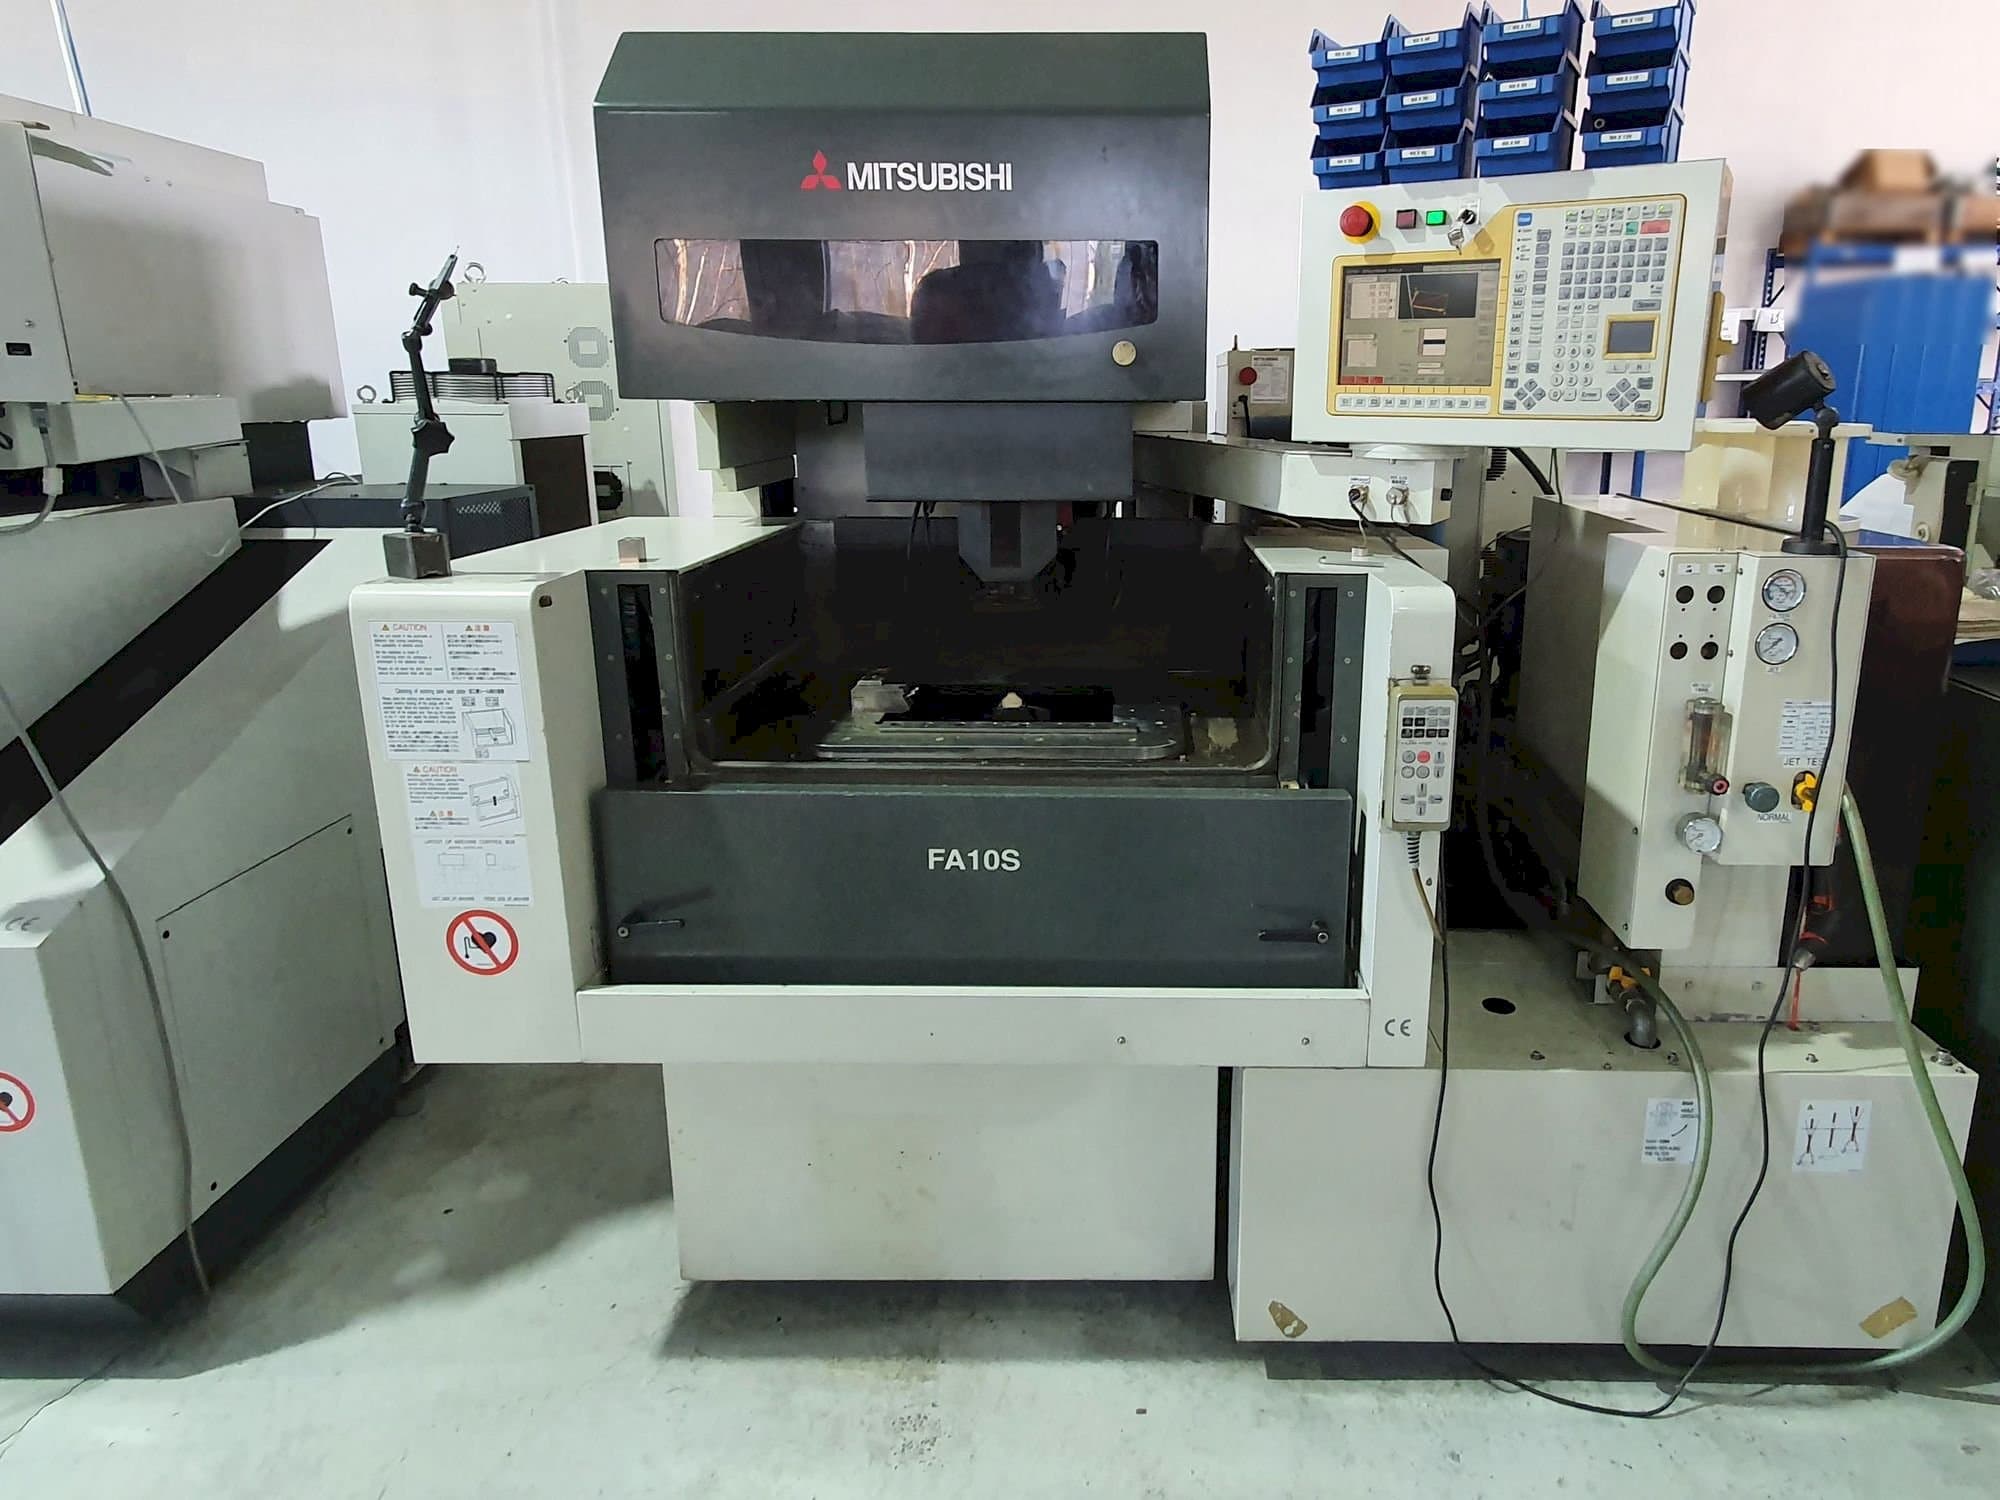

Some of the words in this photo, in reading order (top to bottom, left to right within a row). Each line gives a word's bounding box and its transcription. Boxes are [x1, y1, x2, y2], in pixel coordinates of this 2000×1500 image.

[847, 162, 1012, 191] MITSUBISHI
[423, 765, 457, 773] CAUTION
[1784, 757, 1800, 766] JET
[1807, 757, 1824, 766] TES
[928, 848, 1021, 871] FA10S
[5, 916, 41, 931] CE
[1384, 1018, 1412, 1037] CE
